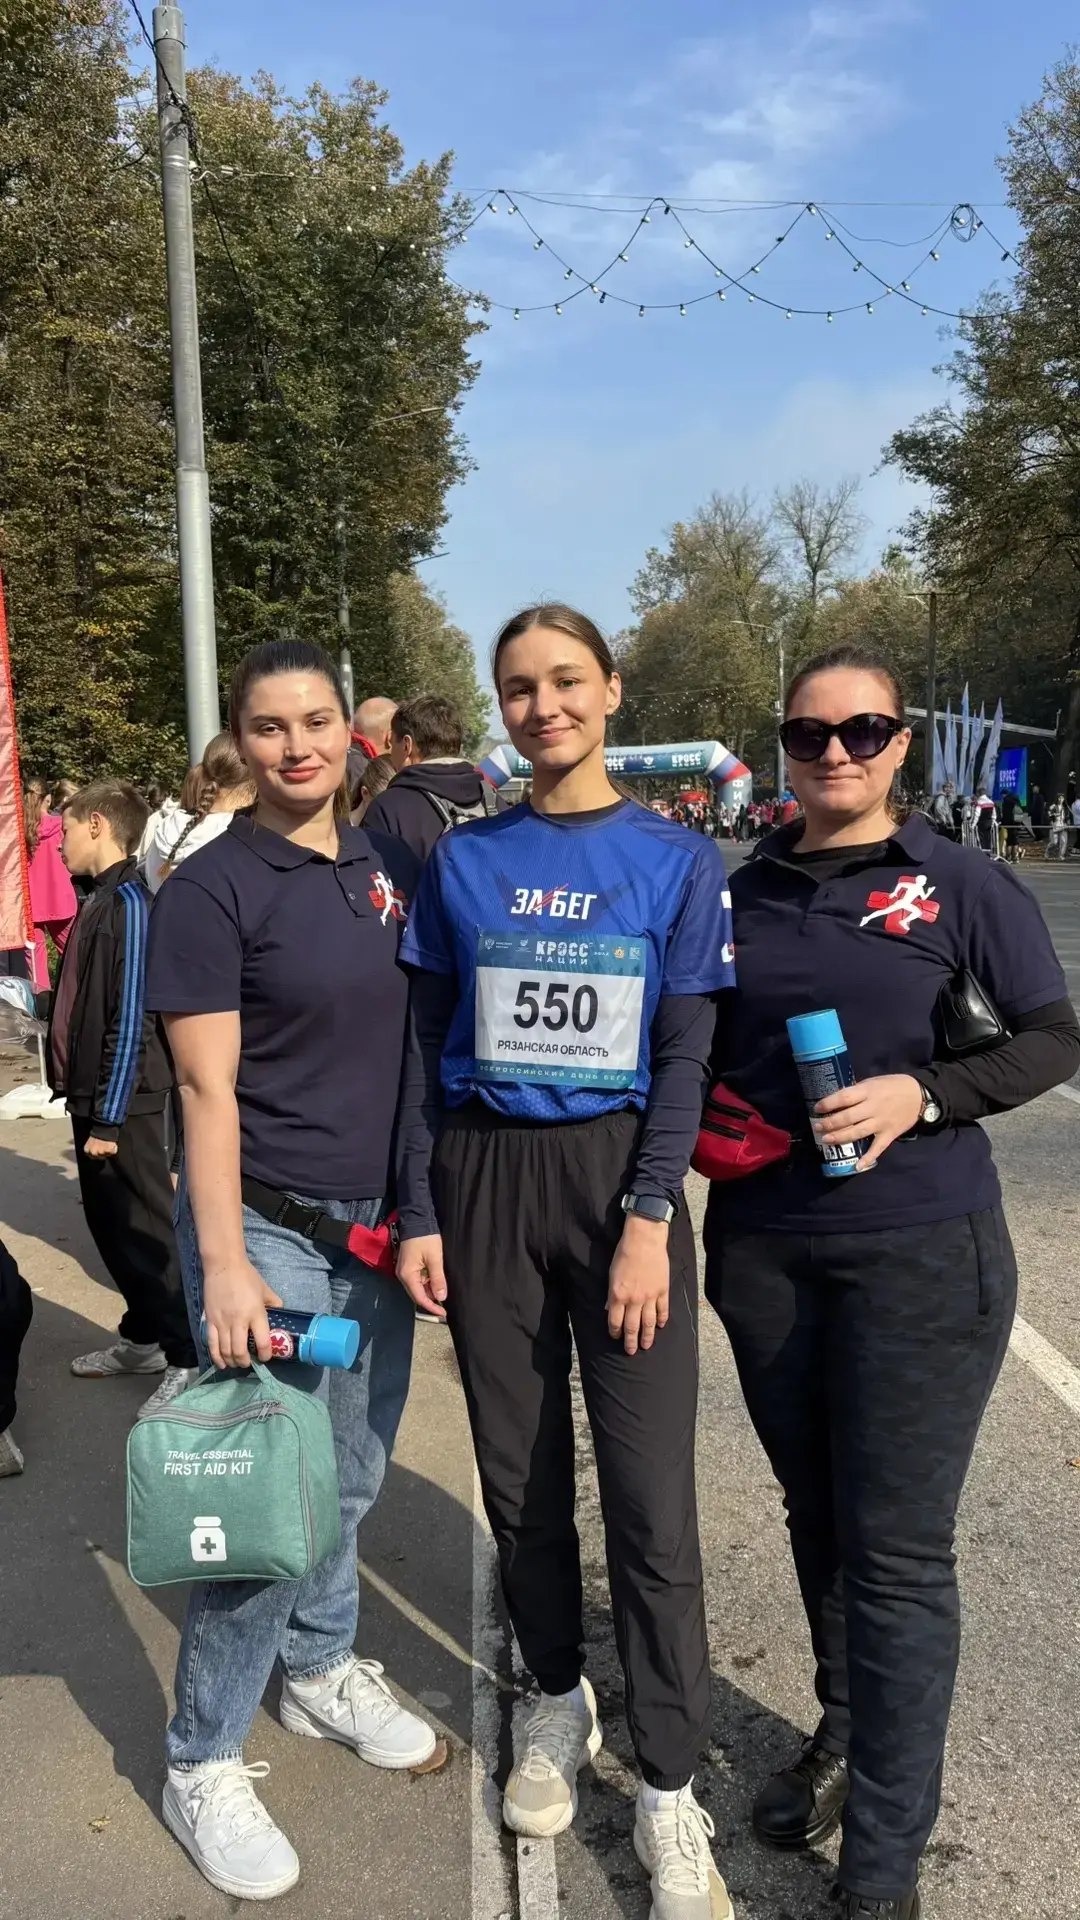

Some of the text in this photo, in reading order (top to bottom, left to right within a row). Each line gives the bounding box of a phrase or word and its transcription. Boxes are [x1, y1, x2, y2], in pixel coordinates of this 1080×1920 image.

[536, 940, 589, 958] КРОСС
[535, 955, 588, 966] НАЦИИ
[513, 981, 599, 1034] 550
[498, 1040, 609, 1058] РЯЗАНСКАЯ ОБЛАСТЬ
[167, 1449, 255, 1460] TRAVEL ESSENTIAL
[163, 1461, 254, 1476] FIRST AID KIT
